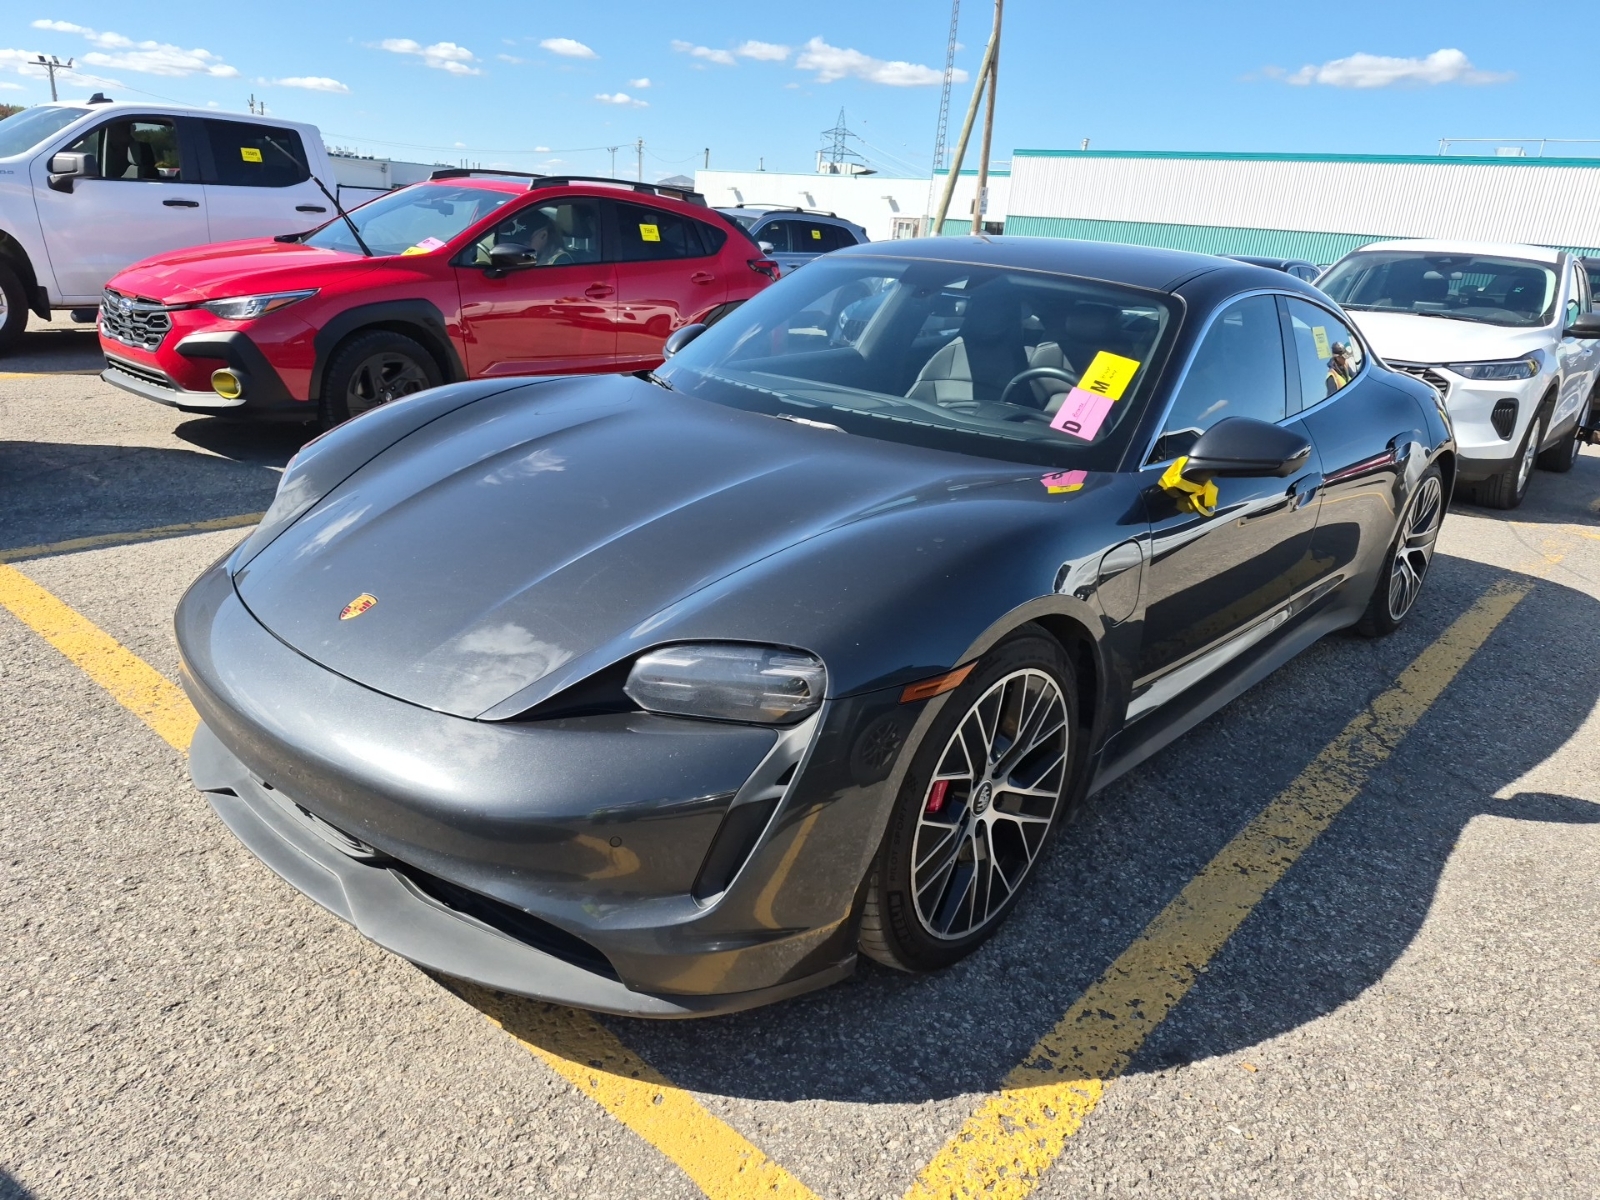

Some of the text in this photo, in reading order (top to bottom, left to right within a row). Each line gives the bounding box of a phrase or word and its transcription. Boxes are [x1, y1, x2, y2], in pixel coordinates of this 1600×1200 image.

[1090, 380, 1110, 394] M
[1062, 420, 1082, 434] D
[893, 805, 908, 846] SPORT
[889, 850, 899, 882] PILOT
